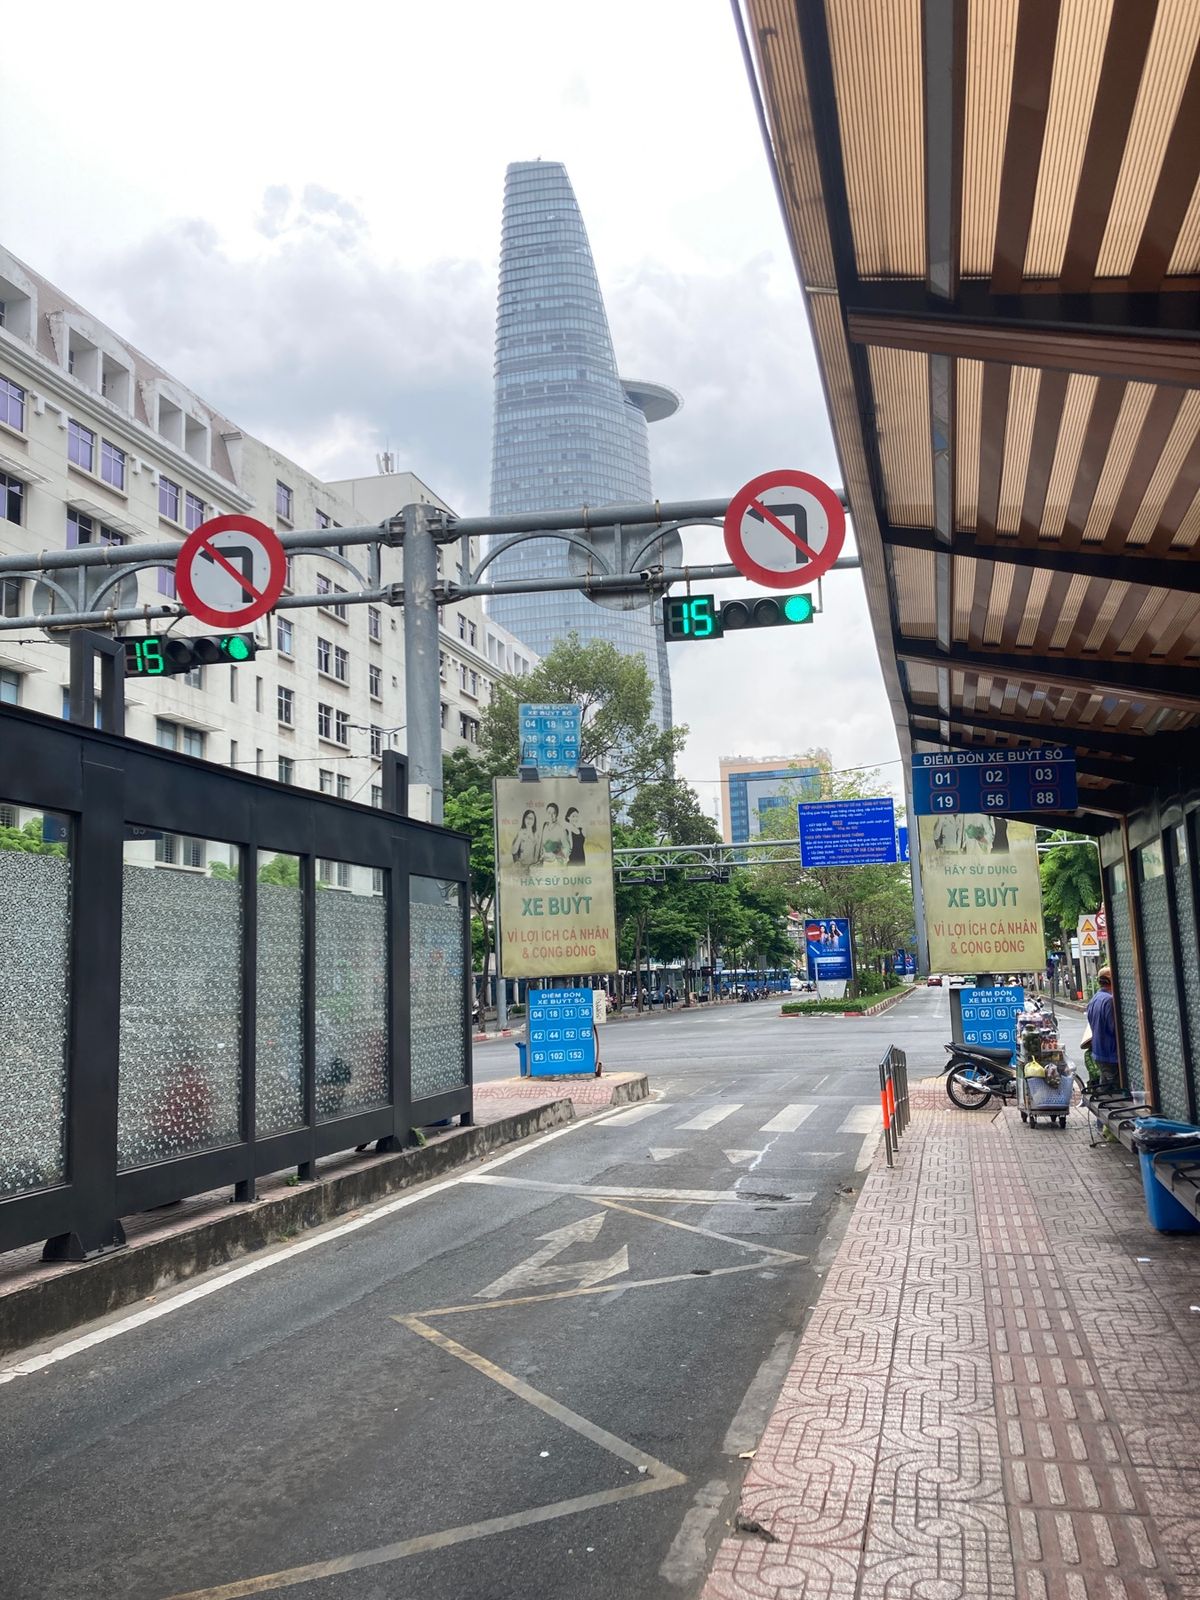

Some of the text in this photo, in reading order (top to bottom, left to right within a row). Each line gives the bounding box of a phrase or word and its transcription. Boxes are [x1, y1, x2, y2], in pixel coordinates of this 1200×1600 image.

[682, 599, 712, 636] 15
[135, 639, 164, 673] 15
[525, 720, 574, 728] 04 18 31
[526, 735, 537, 743] 36
[546, 735, 556, 743] 42
[546, 750, 558, 758] 65
[957, 751, 984, 764] ĐÓN
[988, 752, 1004, 763] XE
[1008, 748, 1041, 761] BUÝT
[1045, 748, 1063, 760] SỐ
[935, 768, 1053, 785] 01 02 03
[936, 792, 1054, 808] 19 56 88
[944, 863, 1017, 877] HÃY SỬ DỤNG
[946, 882, 1018, 908] XE BUÝT
[521, 892, 592, 916] XE BUÝT
[507, 928, 518, 943] VÌ
[520, 930, 538, 944] LỢI
[542, 928, 559, 942] ÍCH
[580, 926, 609, 940] NHÂN
[934, 918, 1038, 939] VÌ LỢI ÍCH CÁ NHÂN
[522, 947, 529, 959] &
[950, 942, 958, 954] &
[549, 1010, 558, 1018] 18
[533, 1032, 542, 1040] 42
[998, 1032, 1008, 1040] 56
[550, 1052, 563, 1060] 102
